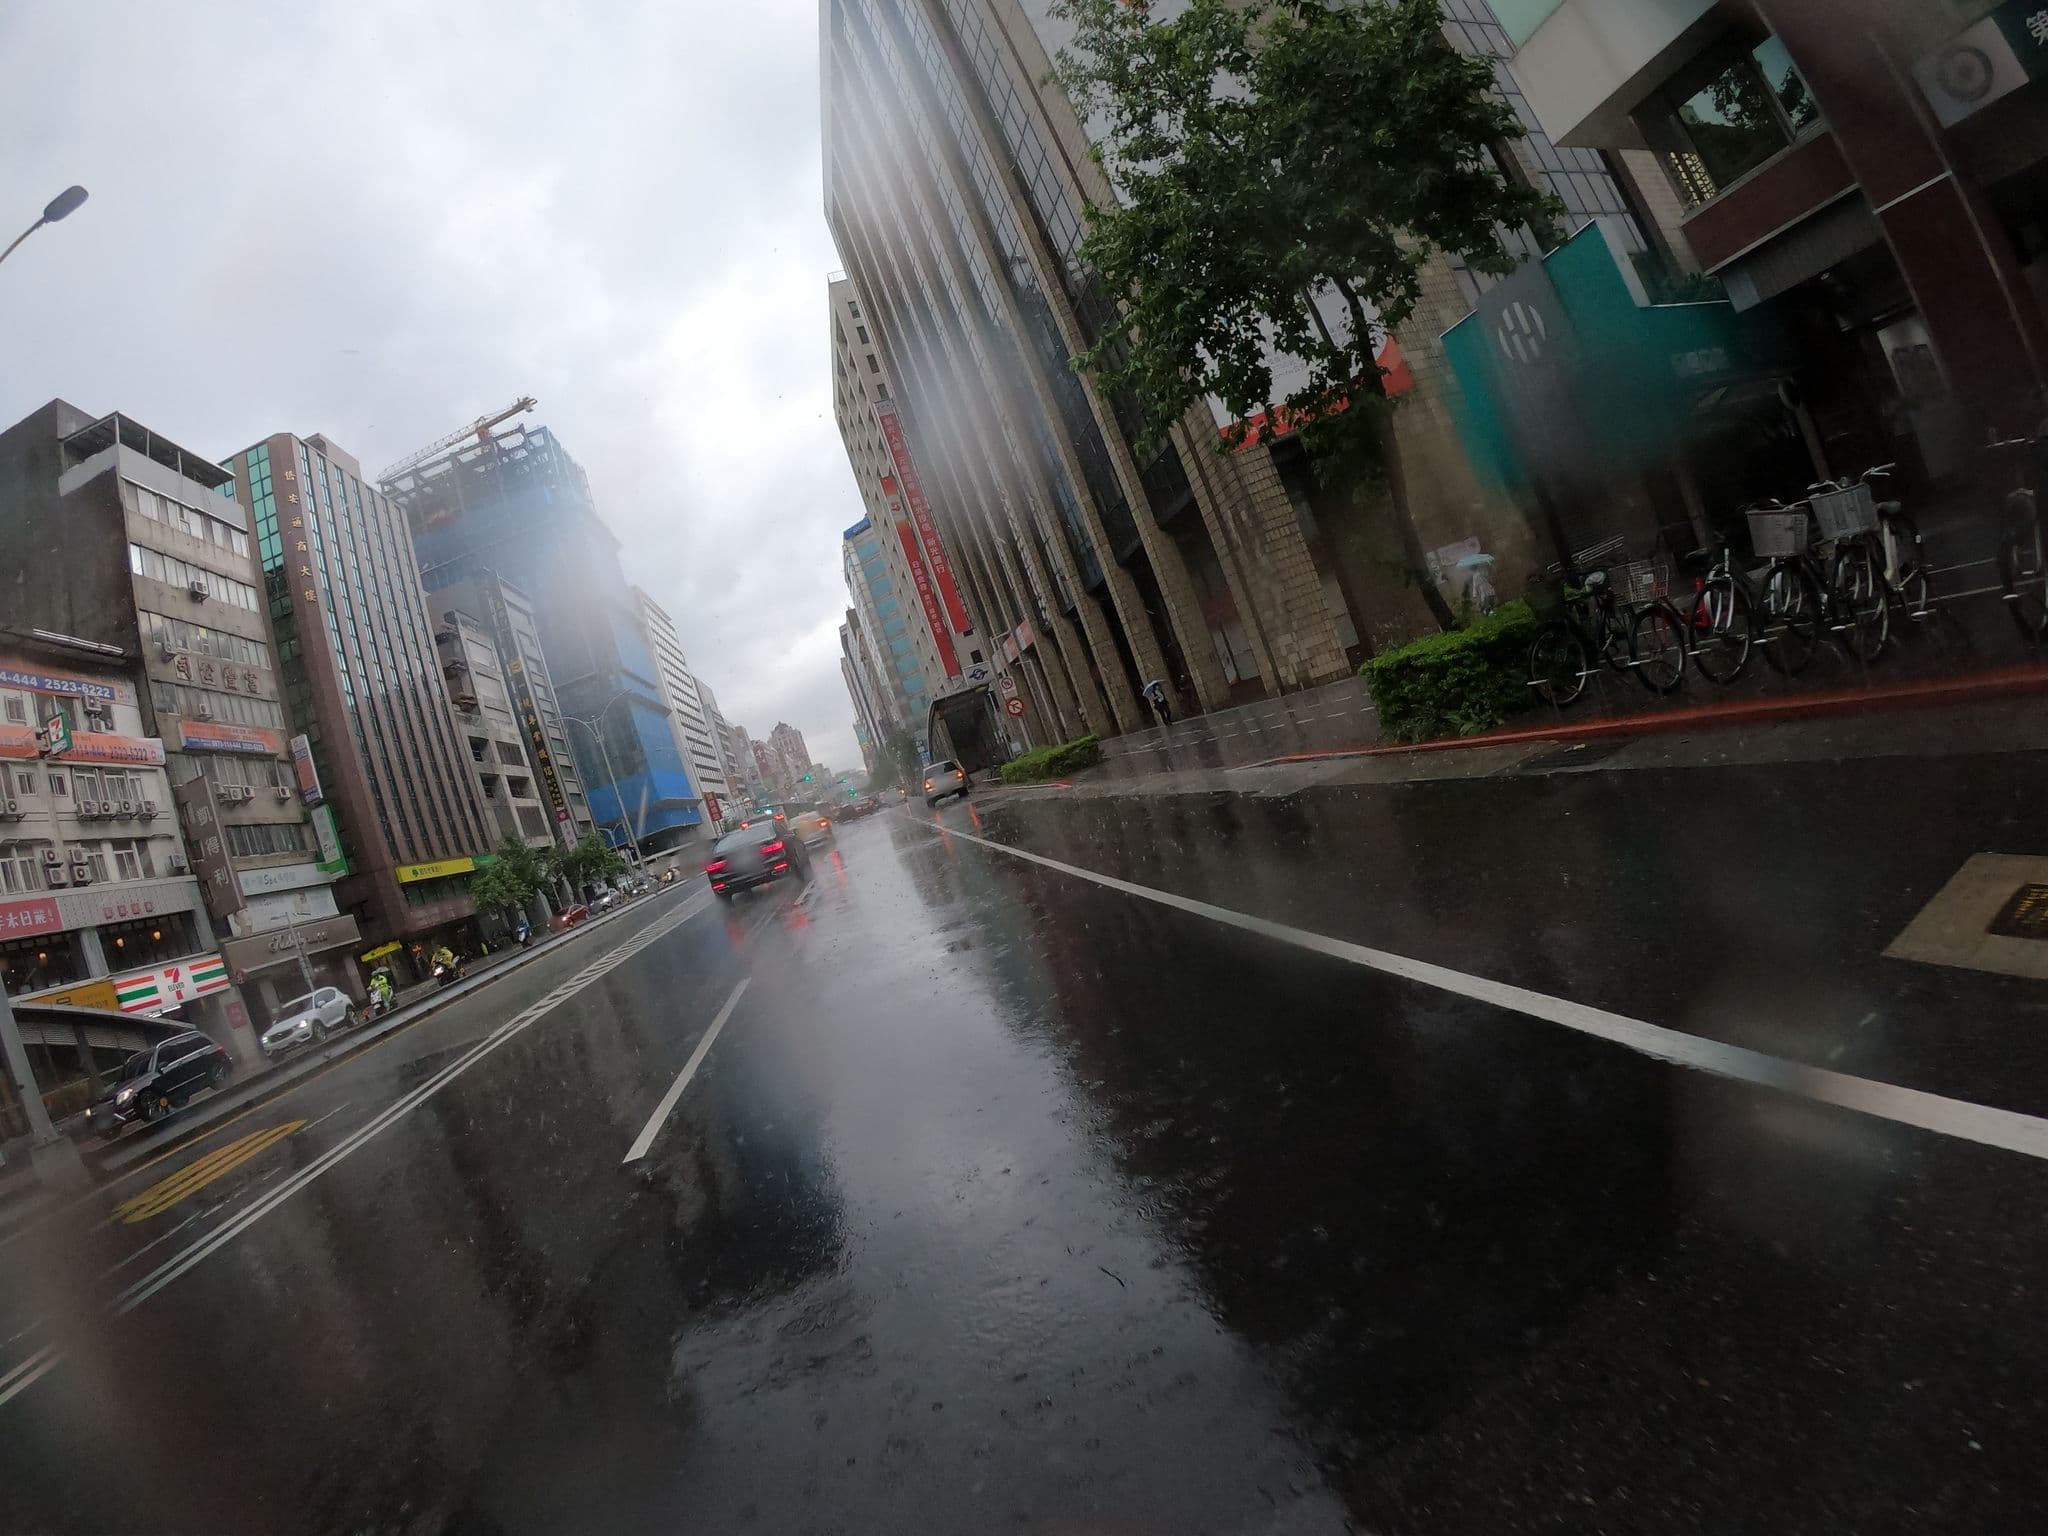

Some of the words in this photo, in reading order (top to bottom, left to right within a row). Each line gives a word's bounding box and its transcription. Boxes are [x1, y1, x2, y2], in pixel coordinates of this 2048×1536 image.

[44, 678, 111, 698] 2523-6222
[196, 805, 229, 887] 凱得利
